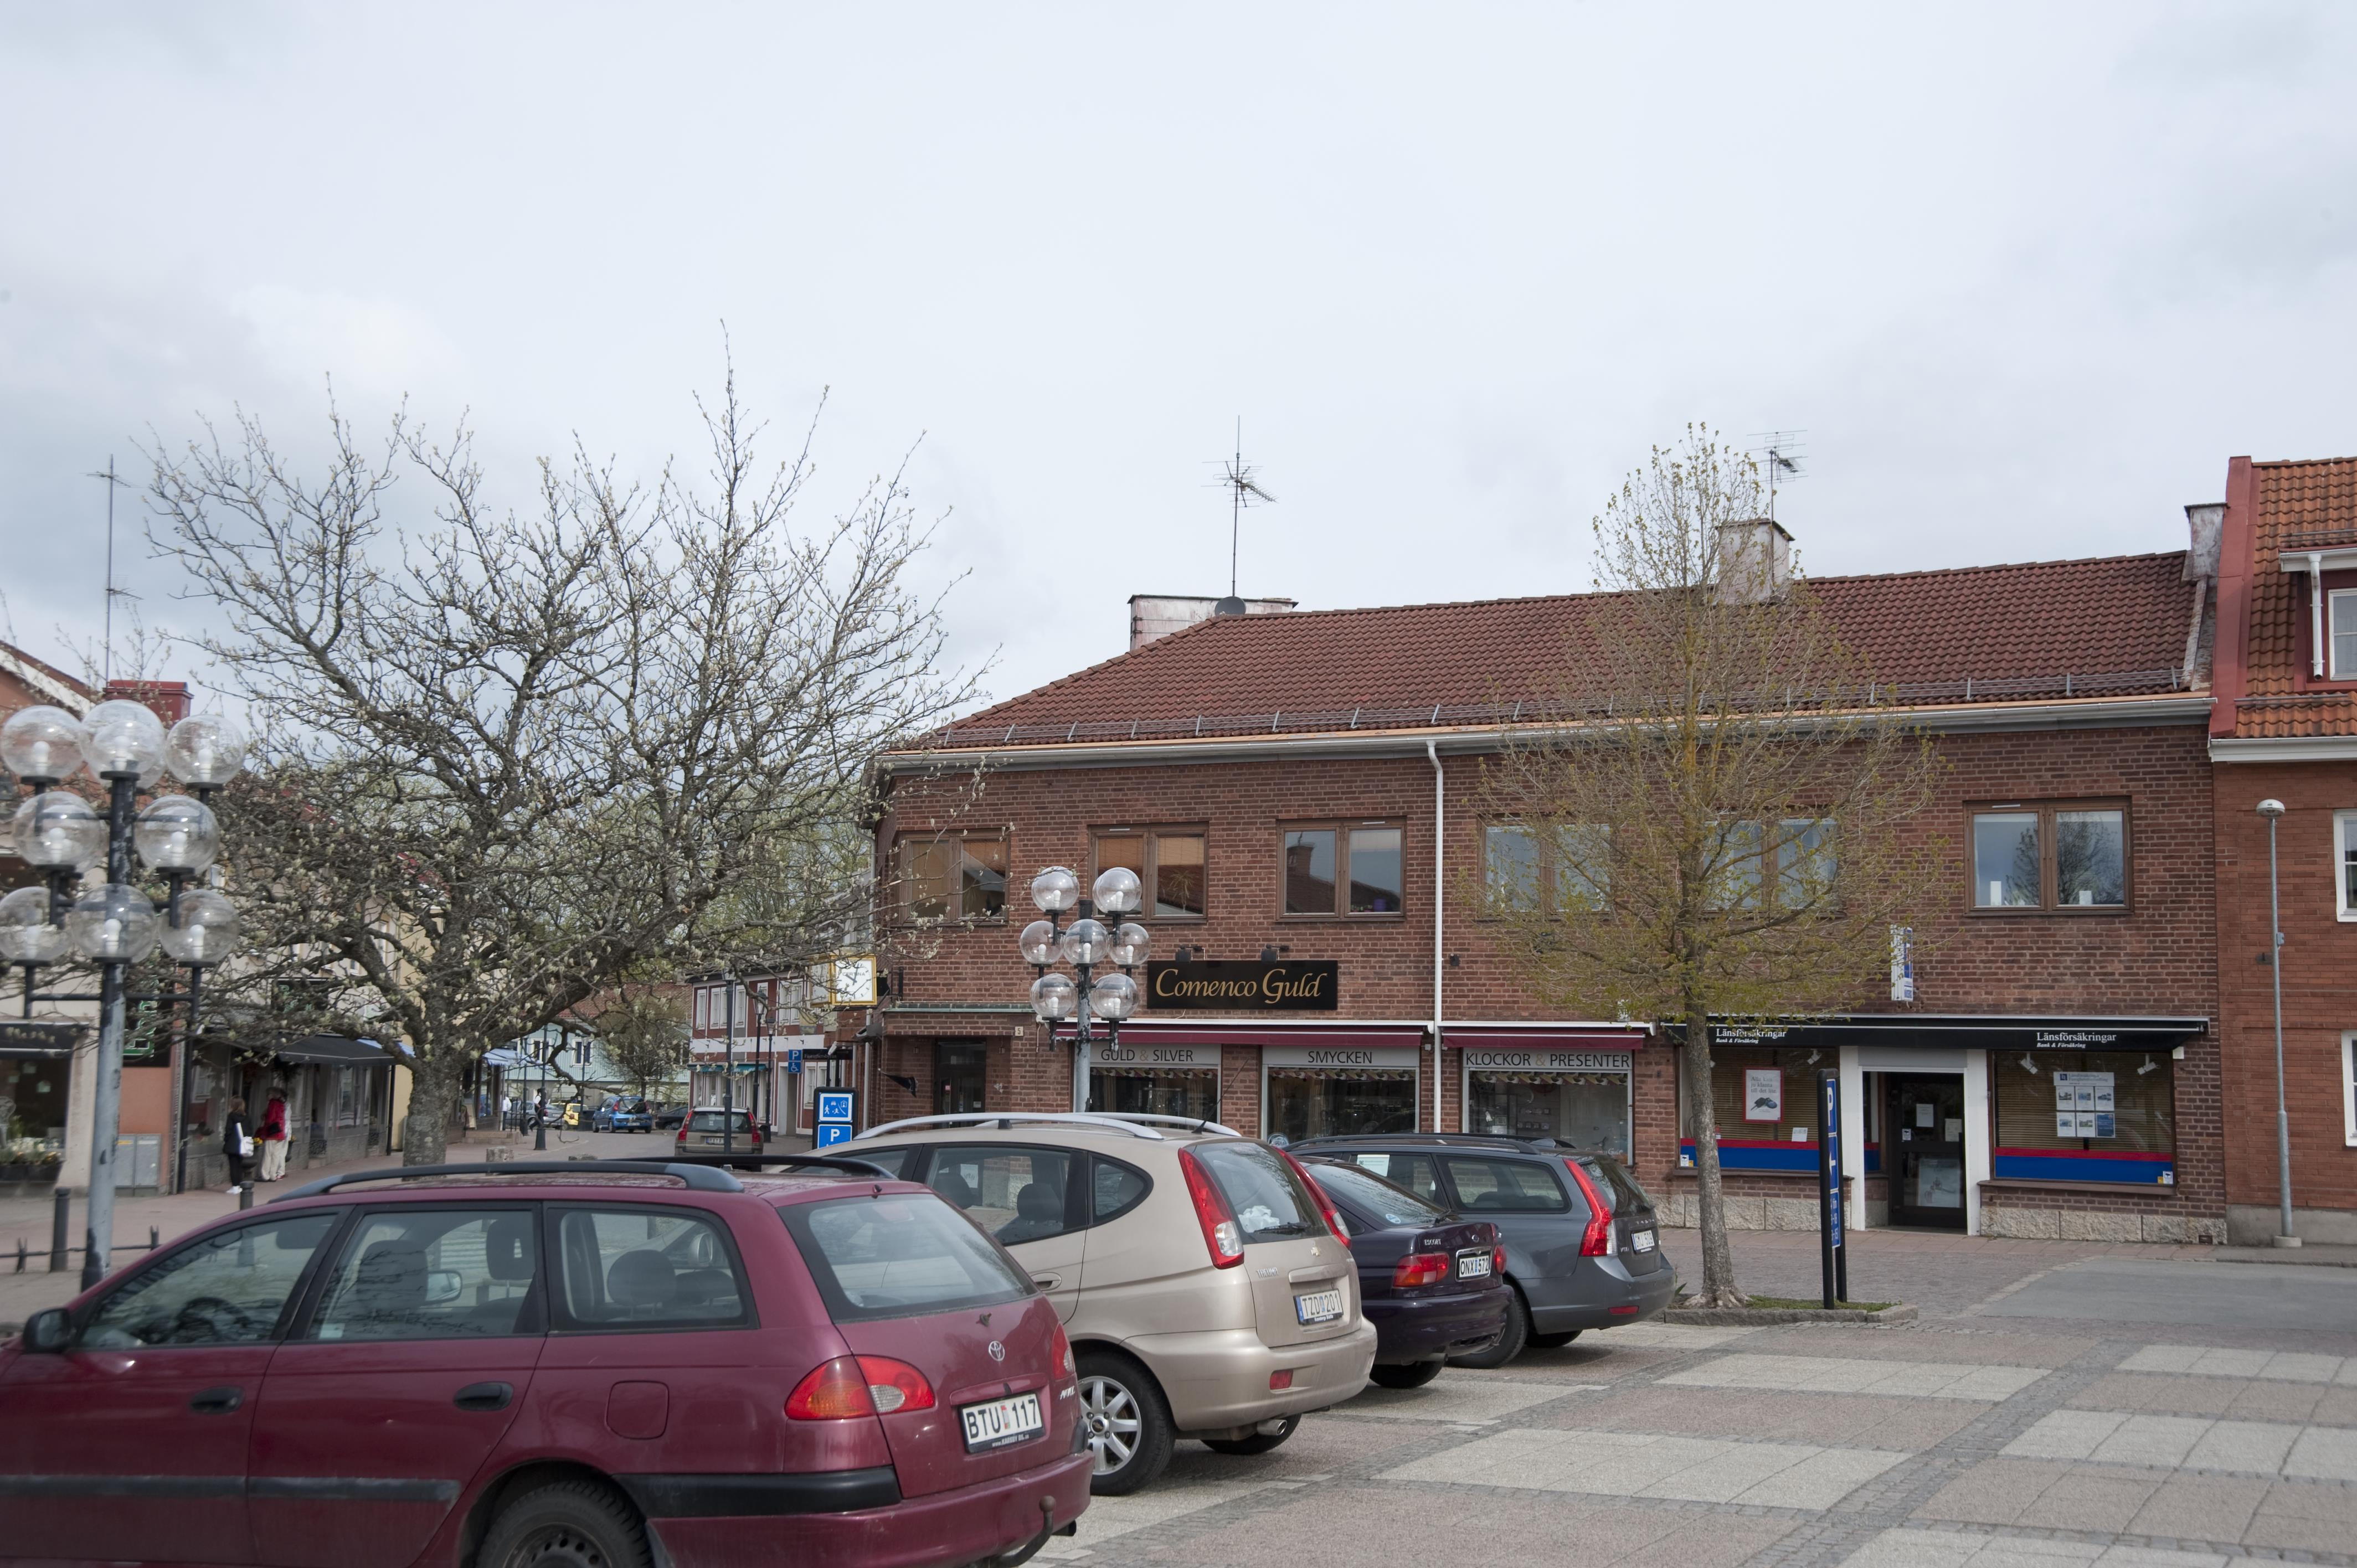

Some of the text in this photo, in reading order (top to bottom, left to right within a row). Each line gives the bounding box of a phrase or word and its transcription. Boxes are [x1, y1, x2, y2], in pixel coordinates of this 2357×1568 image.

[1156, 968, 1328, 1004] Comenco Guld
[2036, 1032, 2117, 1043] Länsförsäkringar
[792, 1051, 799, 1060] P
[1101, 1049, 1193, 1061] GULD & SILVER
[1308, 1051, 1372, 1064] SMYCKEN
[1466, 1053, 1630, 1067] KLOCKOR & PRESENTER
[1827, 1087, 1833, 1126] P
[831, 1128, 840, 1142] P
[1460, 1257, 1489, 1275] ONX 572
[1302, 1293, 1340, 1317] TZD 201
[966, 1399, 1037, 1439] BTU 117
